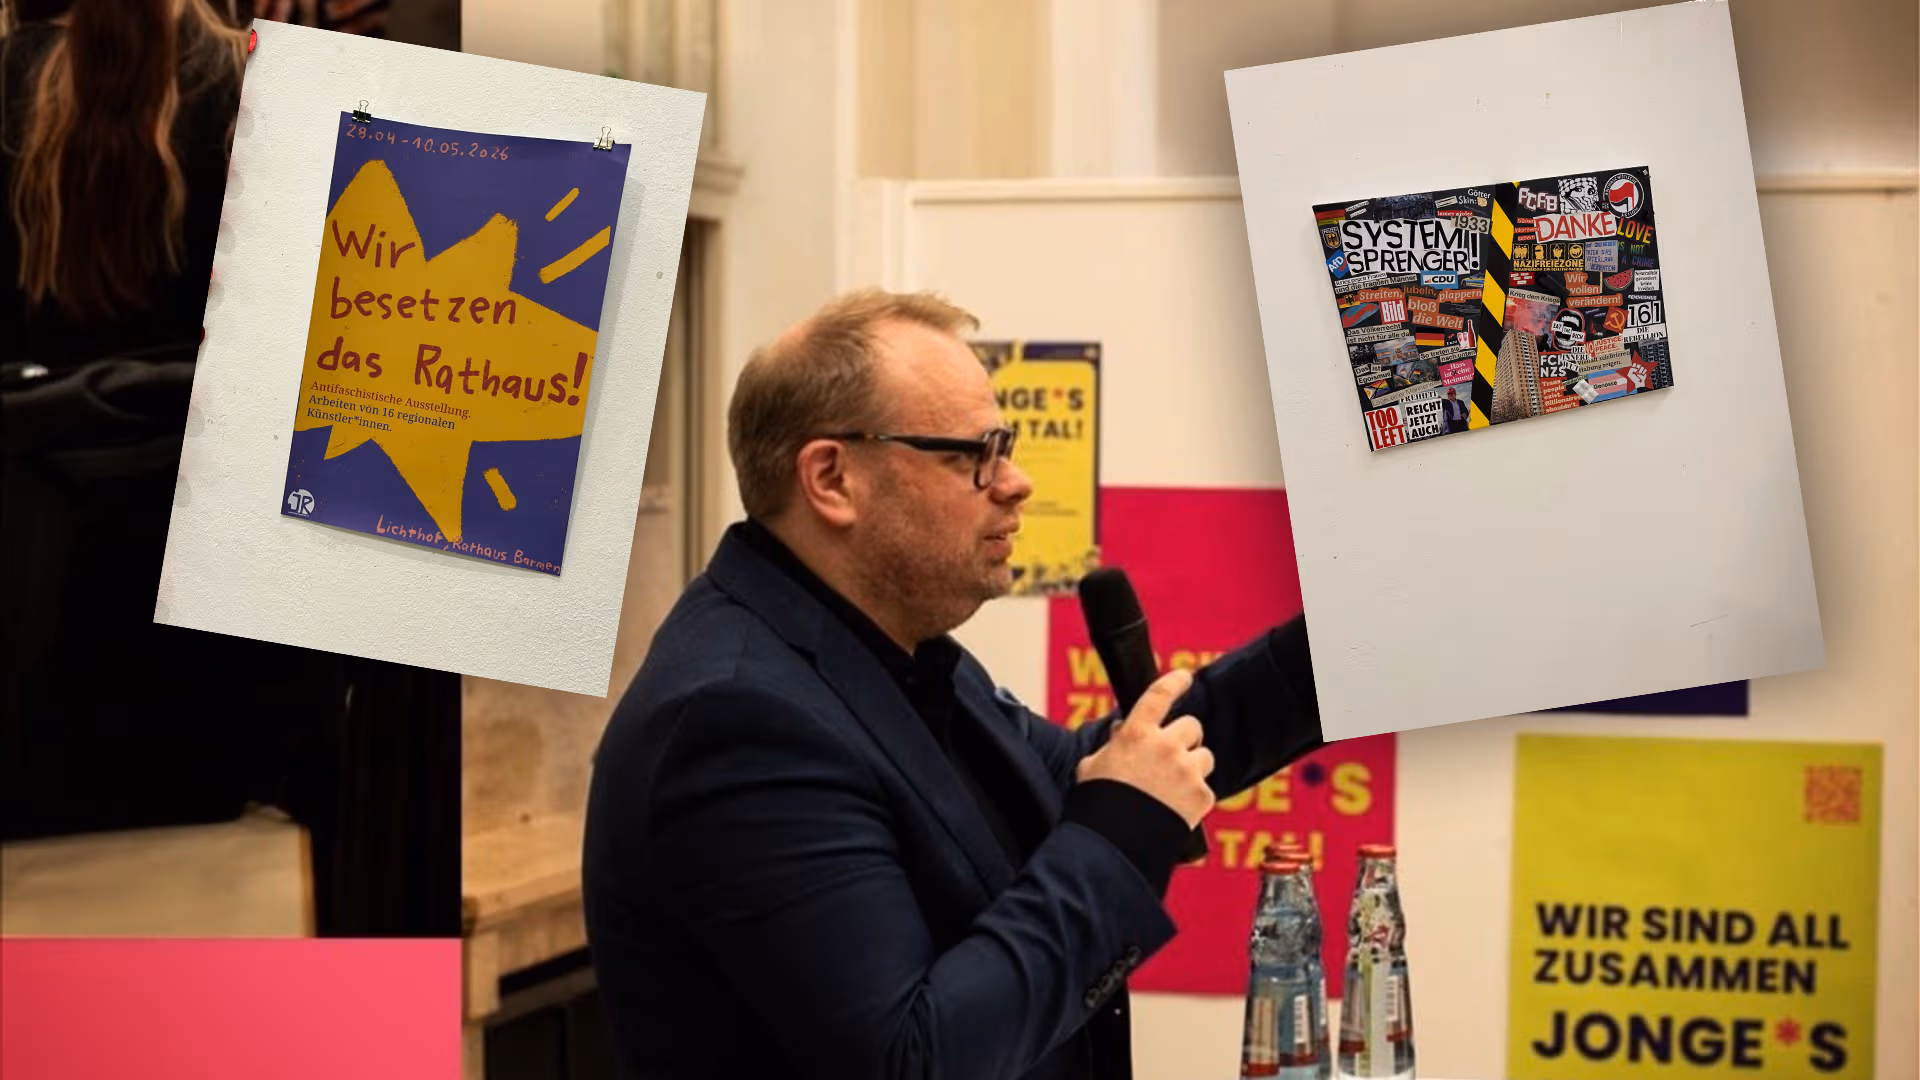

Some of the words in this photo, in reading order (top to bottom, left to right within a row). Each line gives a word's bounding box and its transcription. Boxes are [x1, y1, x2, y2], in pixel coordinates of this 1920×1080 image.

[346, 123, 395, 144] 28.04
[1342, 220, 1463, 249] SYSTEM
[1451, 216, 1488, 233] 1933
[1535, 212, 1615, 242] DANKE
[1617, 217, 1654, 244] LOVE
[331, 219, 416, 268] Wir
[1630, 244, 1645, 255] NOT
[1328, 256, 1344, 273] AfD
[1566, 273, 1585, 283] Wir
[1360, 289, 1404, 300] Streiten,
[1439, 290, 1482, 302] plappern
[1567, 285, 1599, 294] wollen
[330, 276, 517, 325] besetzen
[1381, 300, 1406, 322] Bild
[1408, 298, 1437, 312] bloß
[1568, 295, 1621, 307] verändern!
[1412, 312, 1433, 324] die
[1436, 315, 1463, 329] Welt
[1629, 302, 1660, 325] 161
[1624, 332, 1664, 343] REBELLION
[316, 336, 383, 378] das
[414, 343, 589, 407] Rathaus!
[1540, 366, 1566, 378] NZS
[310, 381, 403, 405] Antifaschistische
[404, 398, 471, 420] Ausstellung.
[1406, 400, 1441, 416] REICHT
[308, 395, 356, 410] Arbeiten
[359, 404, 379, 415] von
[383, 408, 394, 418] 16
[397, 410, 456, 430] regionalen
[1366, 407, 1399, 431] TOO
[1409, 413, 1437, 427] JETZT
[1029, 420, 1083, 439] TAL!
[1372, 424, 1405, 450] LEFT
[1412, 424, 1439, 439] AUCH
[452, 536, 508, 561] Rathaus
[514, 550, 561, 575] Barmen
[1535, 902, 1630, 941] WIR
[1642, 906, 1756, 946] SIND
[1767, 912, 1850, 950] ALL
[1534, 950, 1816, 995] ZUSAMMEN
